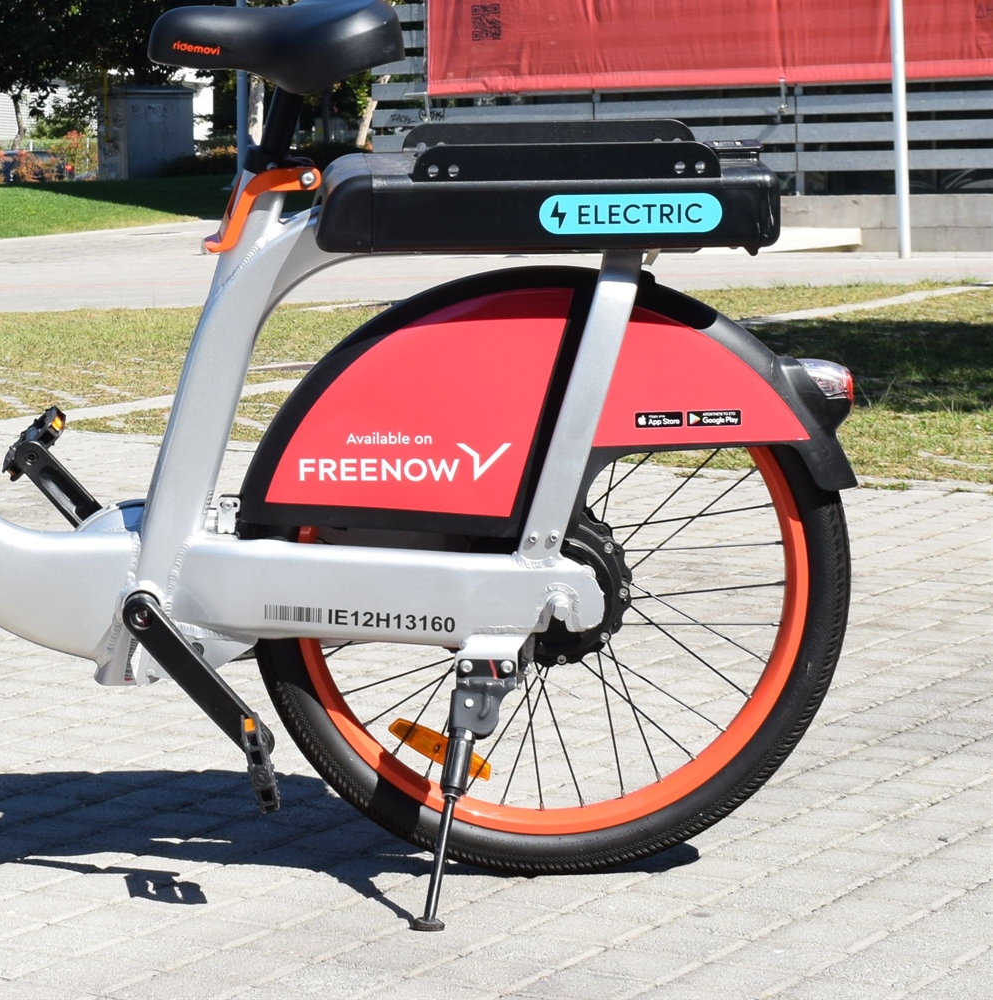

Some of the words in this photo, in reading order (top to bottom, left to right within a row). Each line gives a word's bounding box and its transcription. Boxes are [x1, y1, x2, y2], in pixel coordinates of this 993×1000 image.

[172, 40, 220, 56] ridemovi
[578, 203, 703, 225] ELECTRIC
[648, 418, 662, 426] App
[702, 416, 725, 425] Google
[725, 415, 739, 424] Play
[346, 432, 410, 445] Available
[414, 435, 432, 444] on
[298, 458, 460, 482] FREENOW
[328, 608, 456, 633] IE12H13160
